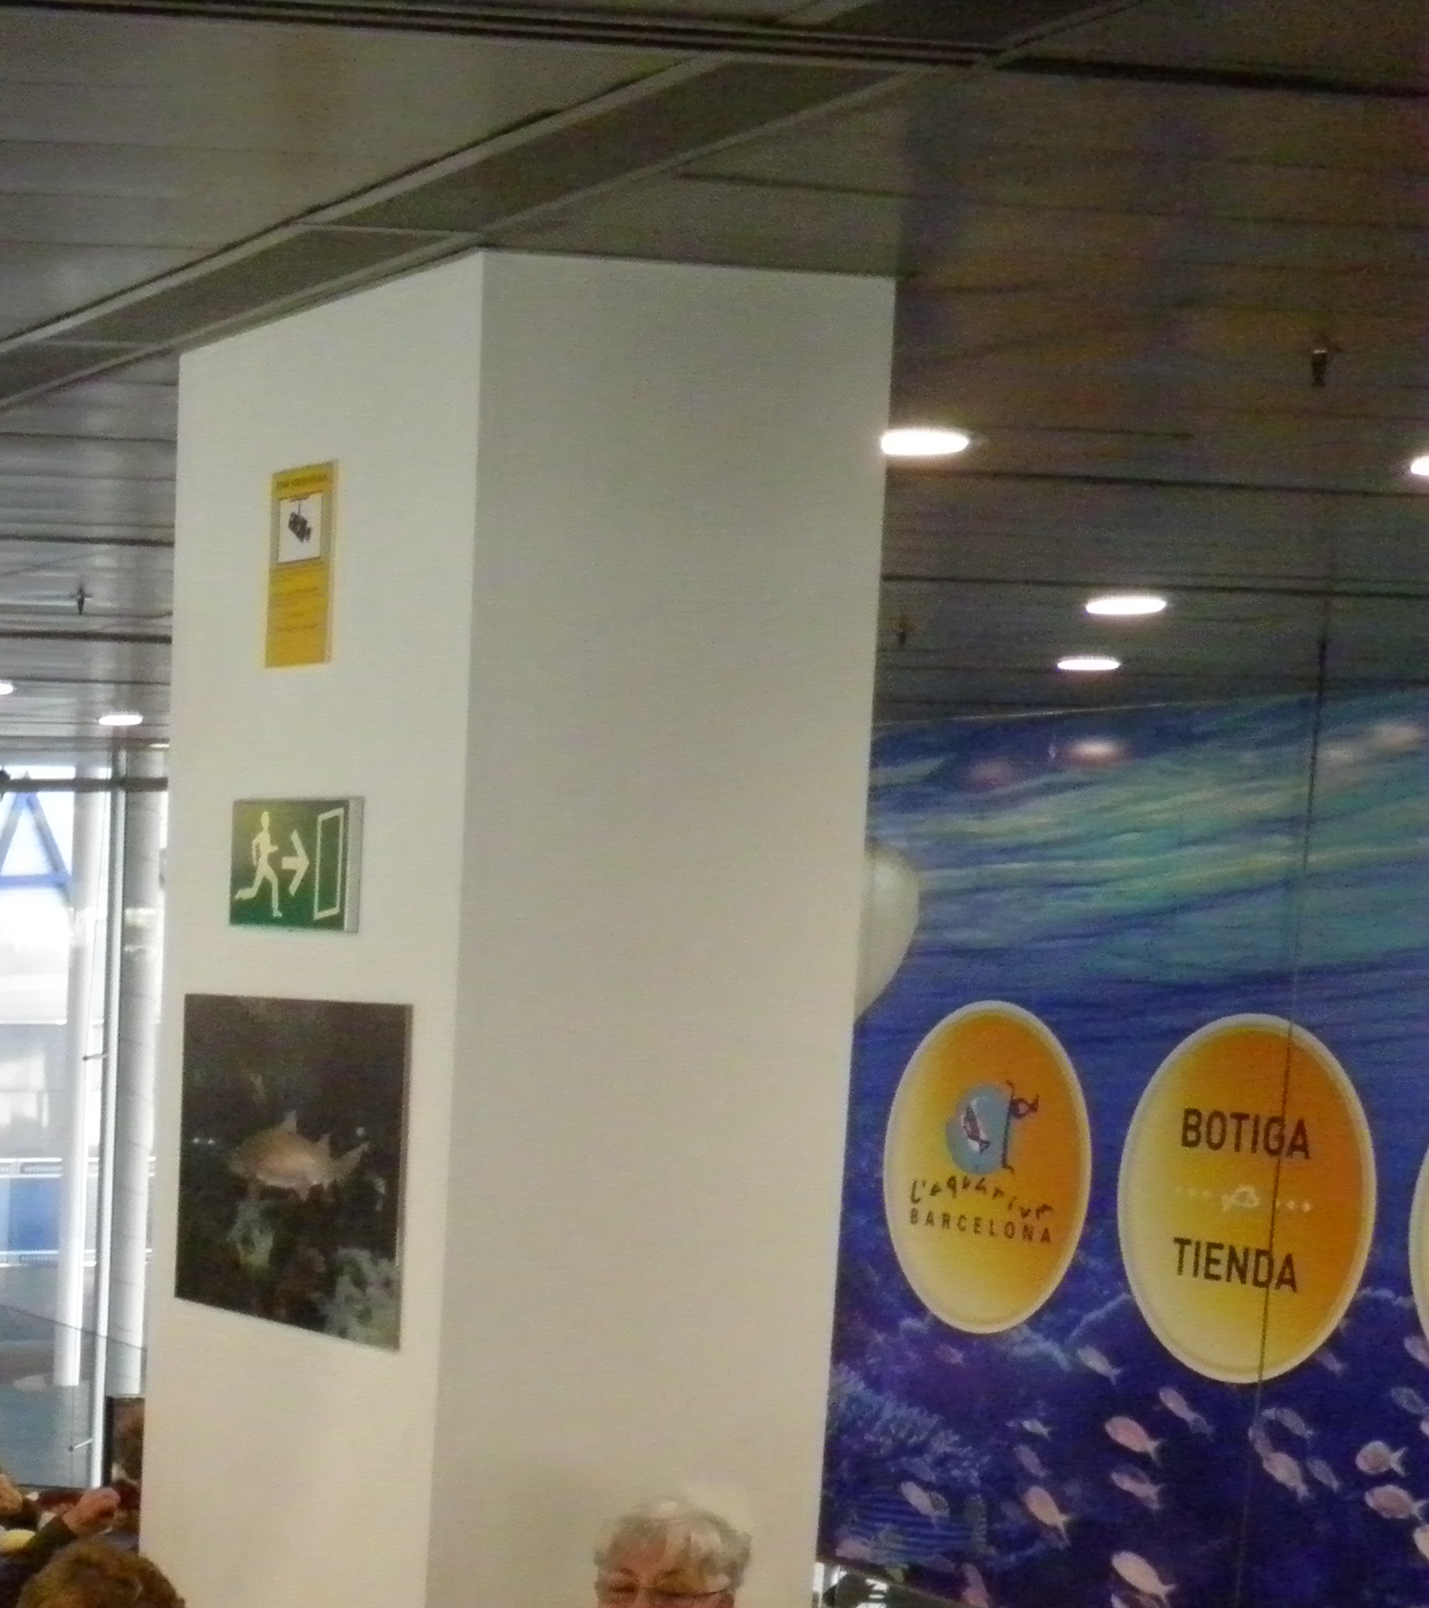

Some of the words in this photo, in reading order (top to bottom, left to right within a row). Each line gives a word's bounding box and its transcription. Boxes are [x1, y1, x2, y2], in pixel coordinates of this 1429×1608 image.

[1181, 1107, 1311, 1160] BOTIGA
[909, 1207, 1052, 1244] BARCELONA
[1173, 1236, 1298, 1293] TIENDA
